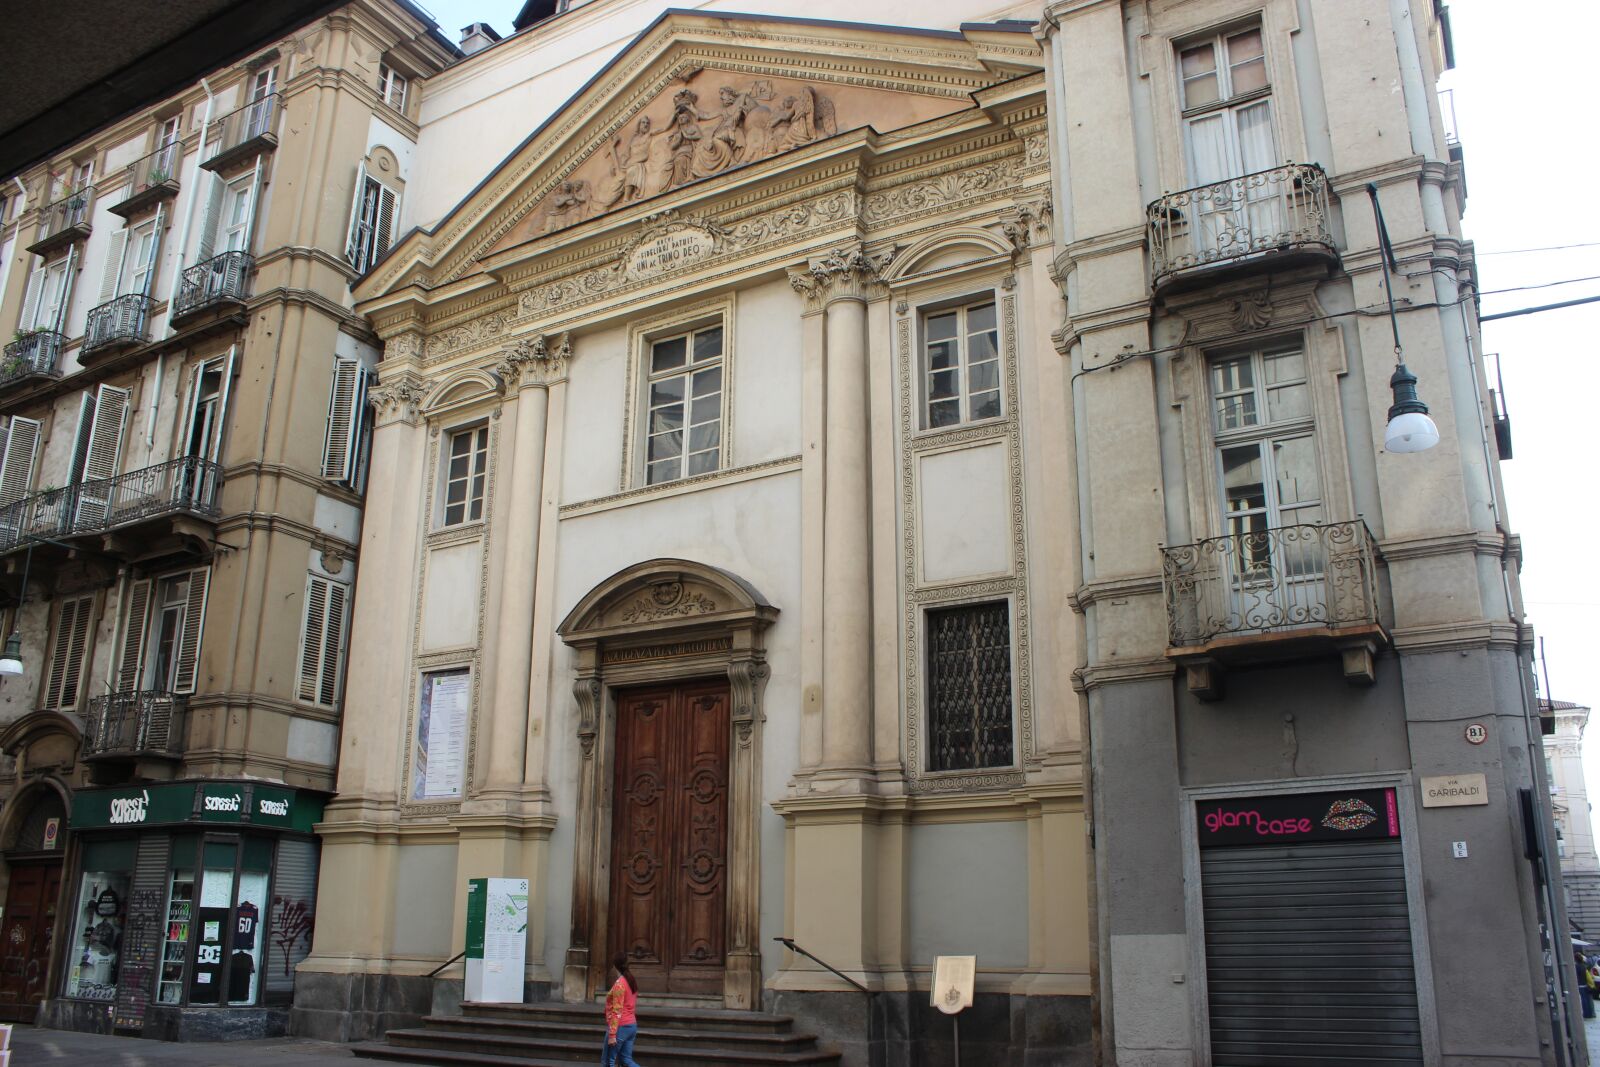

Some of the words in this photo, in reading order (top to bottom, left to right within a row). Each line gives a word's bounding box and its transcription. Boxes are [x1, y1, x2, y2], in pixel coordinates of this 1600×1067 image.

[672, 236, 693, 248] PATUIT
[637, 260, 648, 272] UNI
[658, 249, 680, 264] TRINO
[684, 244, 700, 257] DEO
[1429, 786, 1480, 798] GARIBALDI
[238, 917, 252, 933] 60
